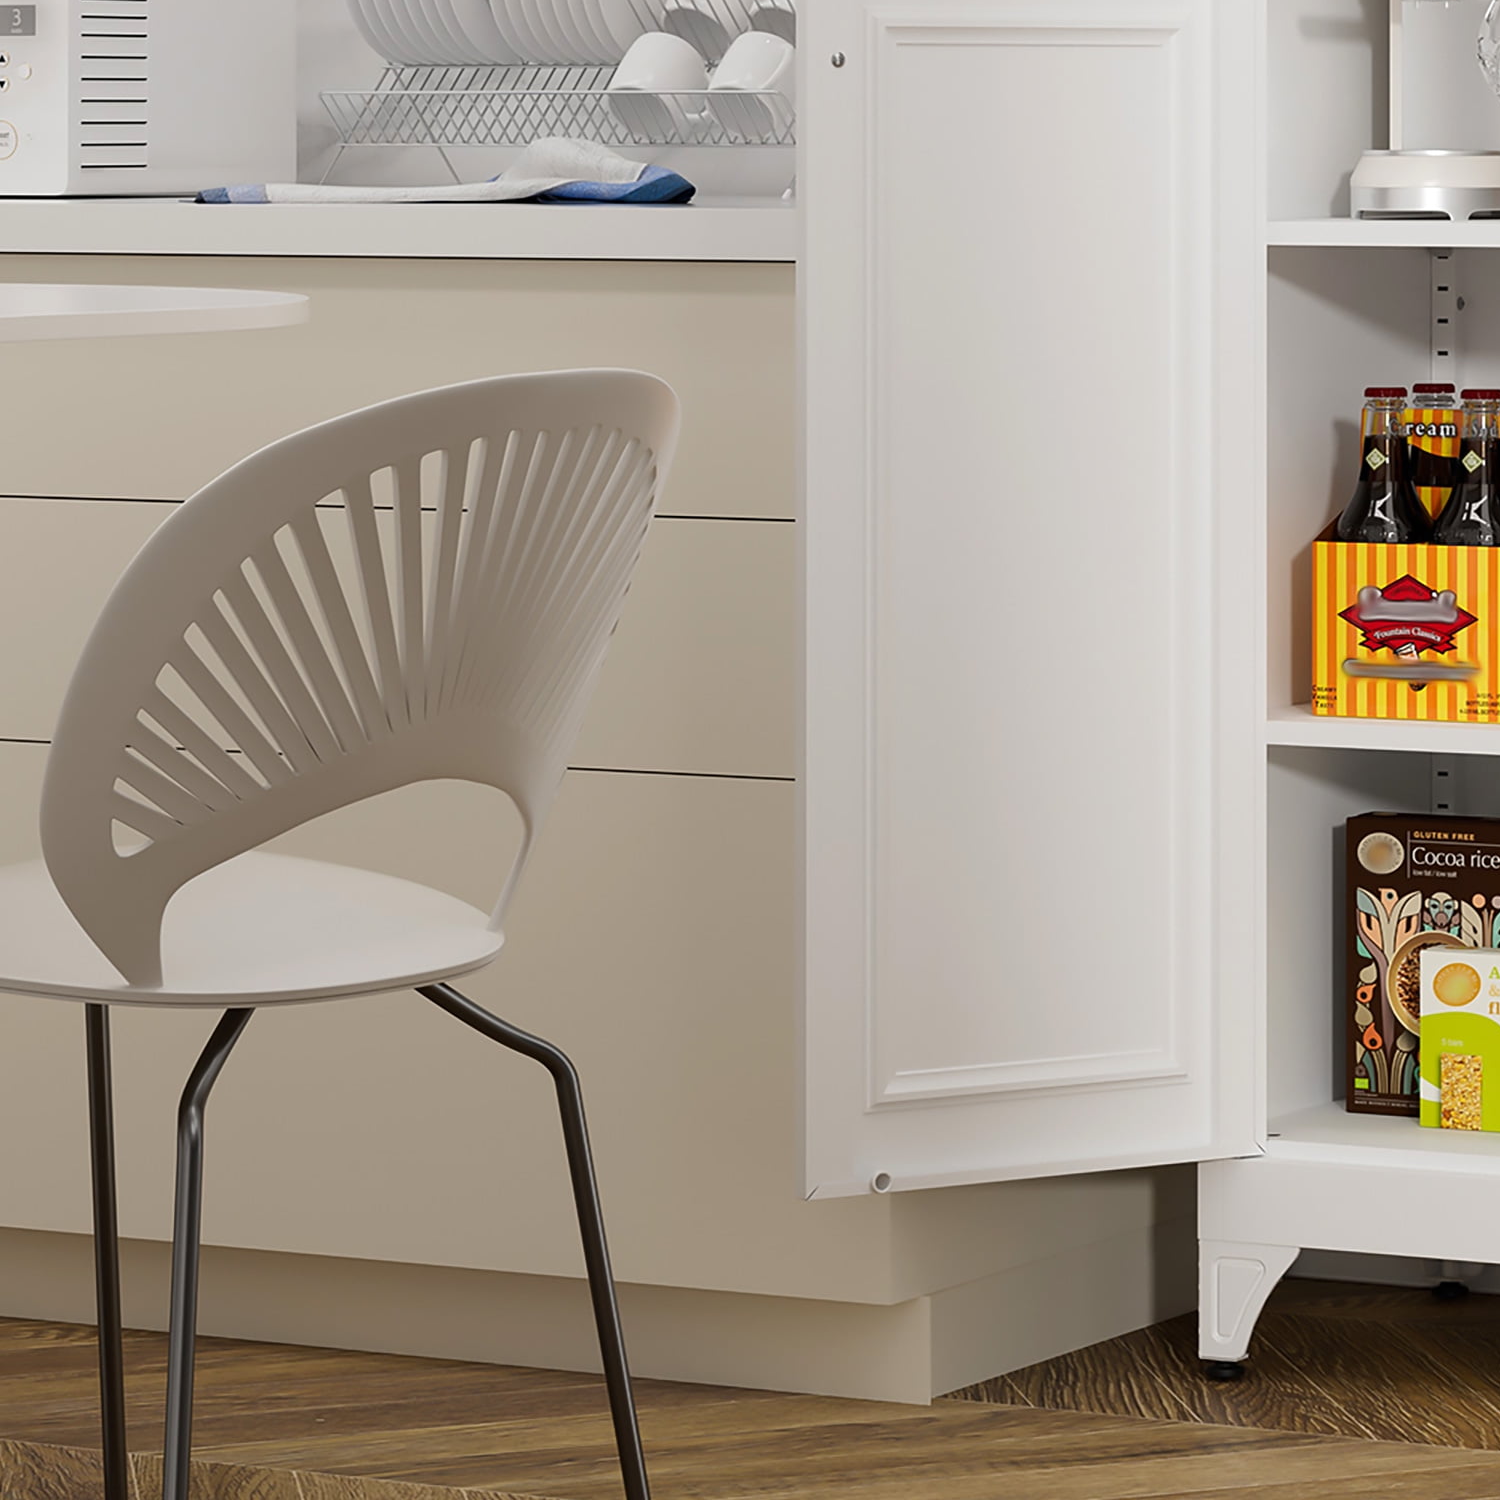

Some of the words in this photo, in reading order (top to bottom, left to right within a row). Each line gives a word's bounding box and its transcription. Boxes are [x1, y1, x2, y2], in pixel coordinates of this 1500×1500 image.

[12, 8, 22, 26] 3
[1389, 419, 1457, 438] Cream
[1412, 830, 1450, 840] GLUTEN
[1451, 832, 1476, 842] FREE
[1411, 846, 1466, 868] Cocoa
[1488, 984, 1500, 999] &
